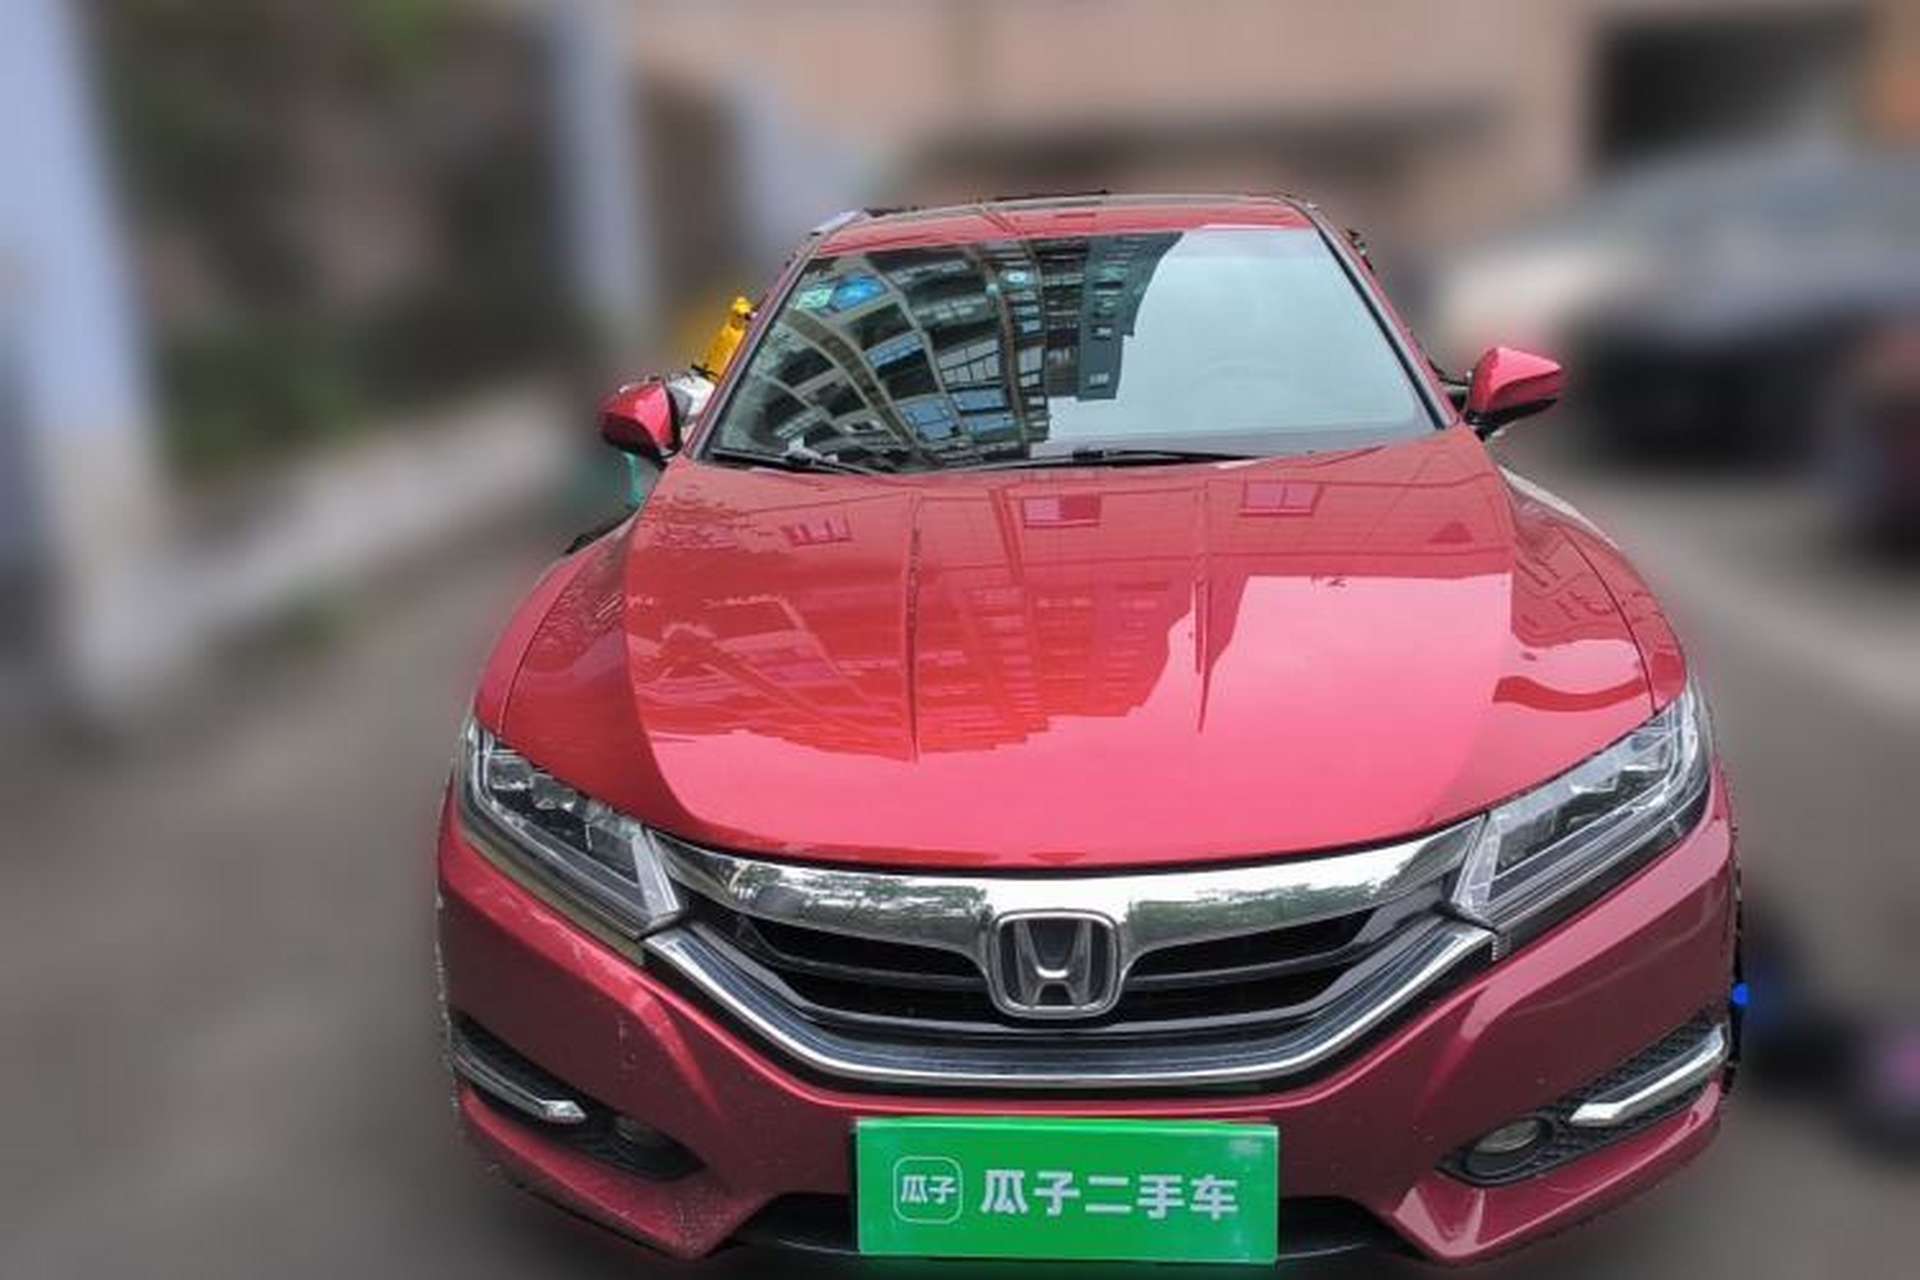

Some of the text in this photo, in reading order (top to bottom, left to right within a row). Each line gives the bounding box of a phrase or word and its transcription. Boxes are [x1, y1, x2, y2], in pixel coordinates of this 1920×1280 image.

[900, 1174, 958, 1205] 瓜子
[980, 1168, 1240, 1220] 瓜子二手车
